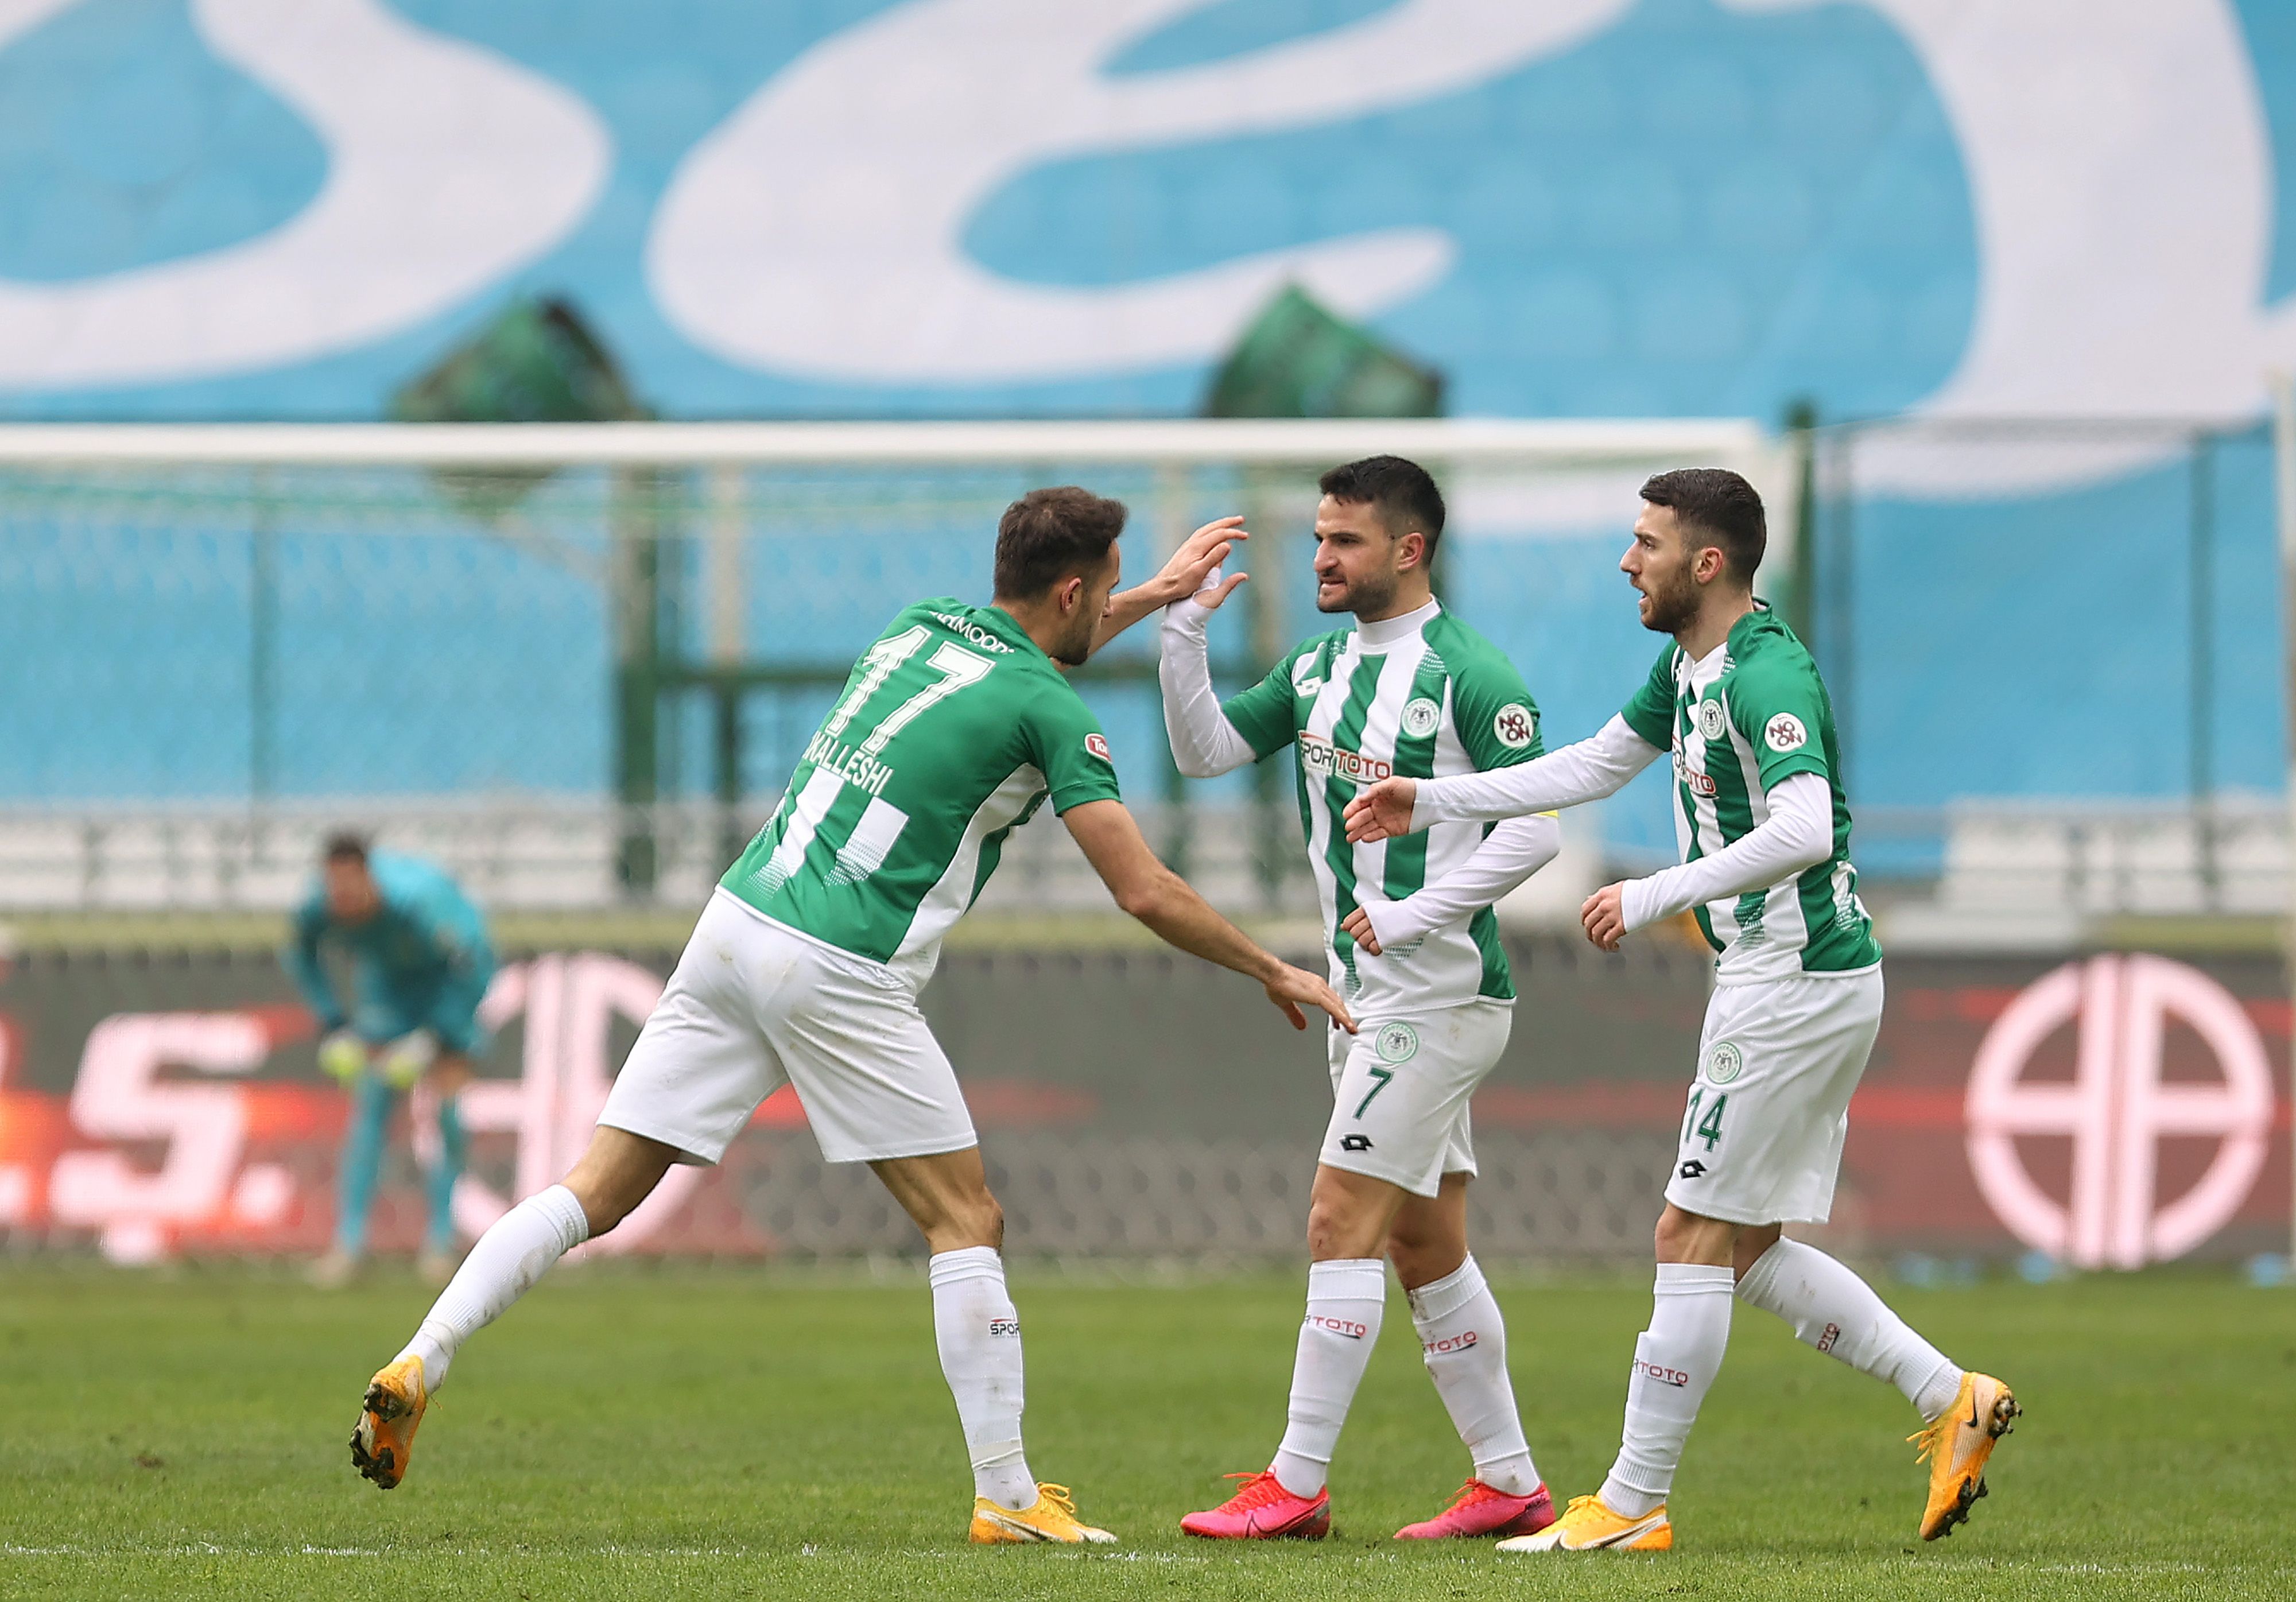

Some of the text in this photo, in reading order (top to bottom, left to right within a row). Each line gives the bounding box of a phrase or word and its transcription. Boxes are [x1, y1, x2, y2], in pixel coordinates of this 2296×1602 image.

[825, 623, 996, 758] 17
[1352, 1065, 1395, 1120] 7
[1685, 1086, 1728, 1152] 14
